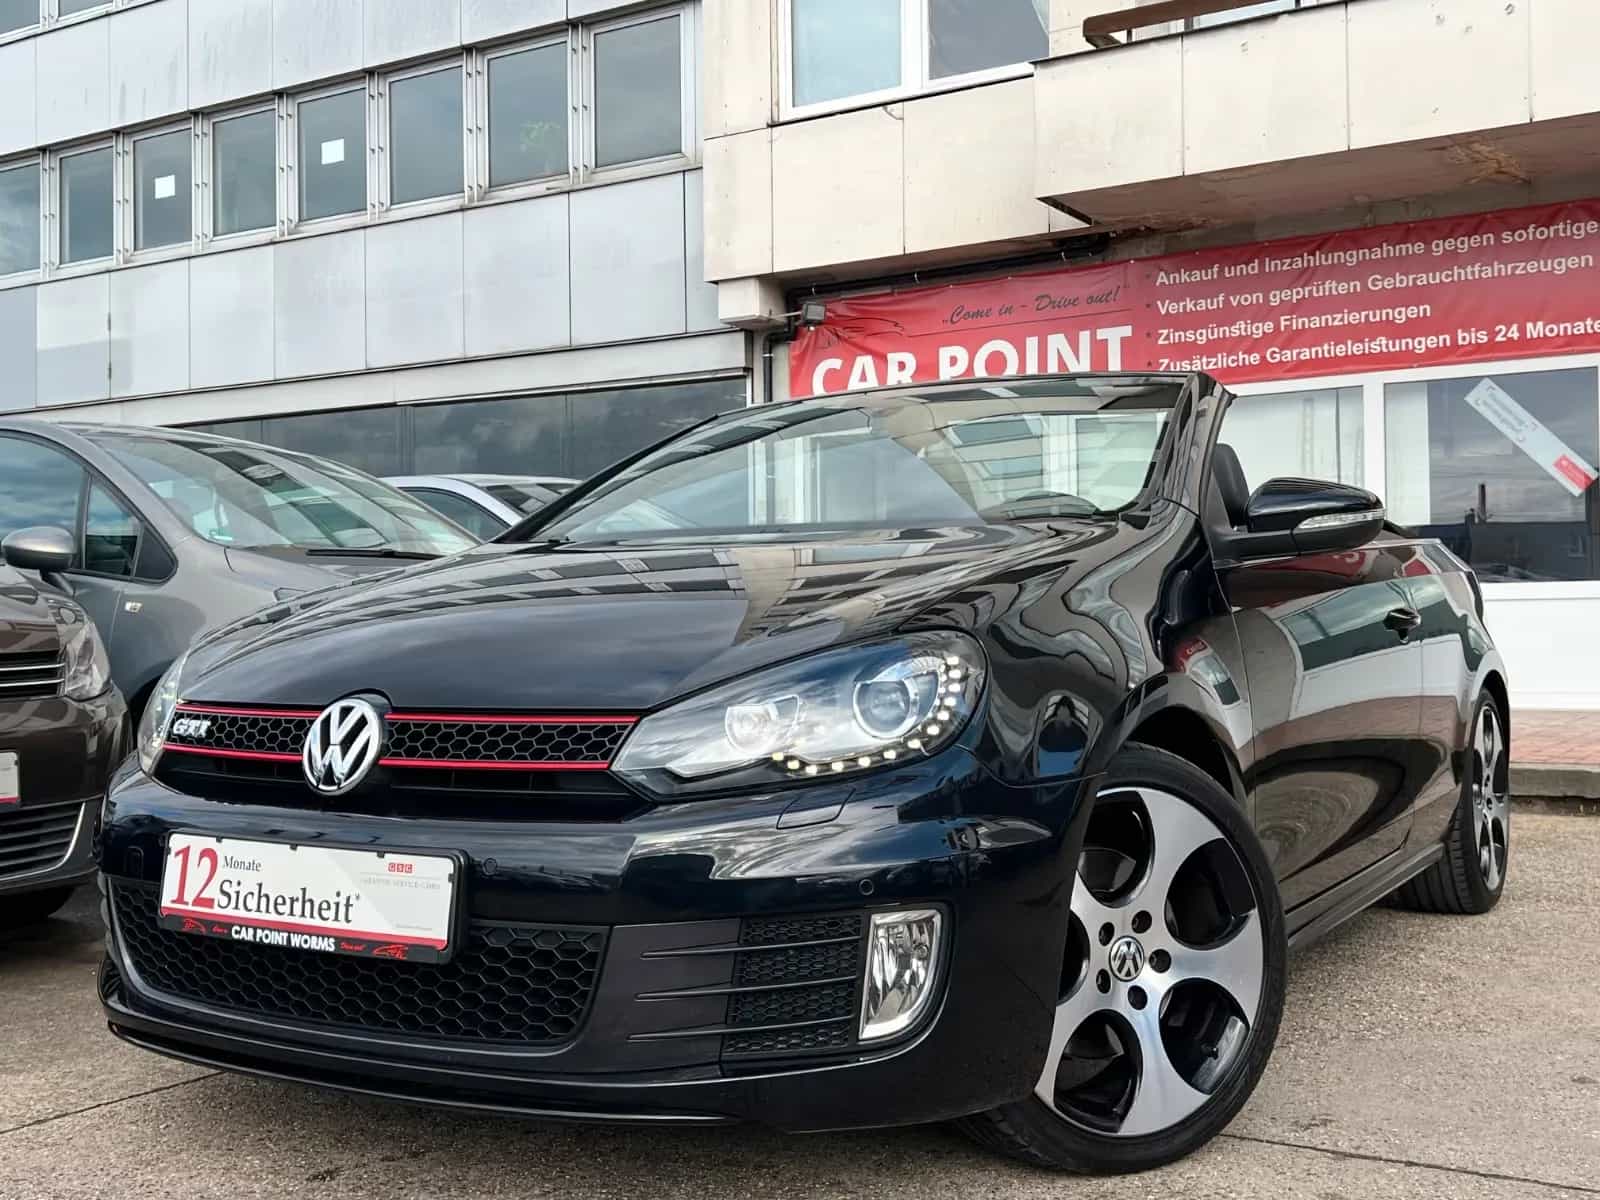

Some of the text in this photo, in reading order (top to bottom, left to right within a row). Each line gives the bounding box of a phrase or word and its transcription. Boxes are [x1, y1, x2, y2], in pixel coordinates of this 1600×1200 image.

[1155, 219, 1599, 287] Ankauf und Inzahlungnahme gegen sofortige
[997, 303, 1015, 317] in
[1034, 294, 1079, 312] Drive
[1156, 253, 1594, 316] Verkauf von geprüften Gebrauchtfahrzeugen
[1157, 303, 1432, 346] Zinsgünstige Finanzierungen
[1158, 351, 1261, 372] Zusätzliche
[1265, 333, 1451, 364] Garantieleistungen
[1457, 327, 1489, 346] bis
[1494, 323, 1521, 343] 24
[811, 324, 1133, 397] CAR POINT
[172, 718, 212, 738] GTI
[170, 844, 219, 910] 12
[222, 855, 262, 872] Monate
[231, 925, 254, 942] CAR
[256, 928, 289, 947] POINT
[290, 933, 336, 952] WORMS
